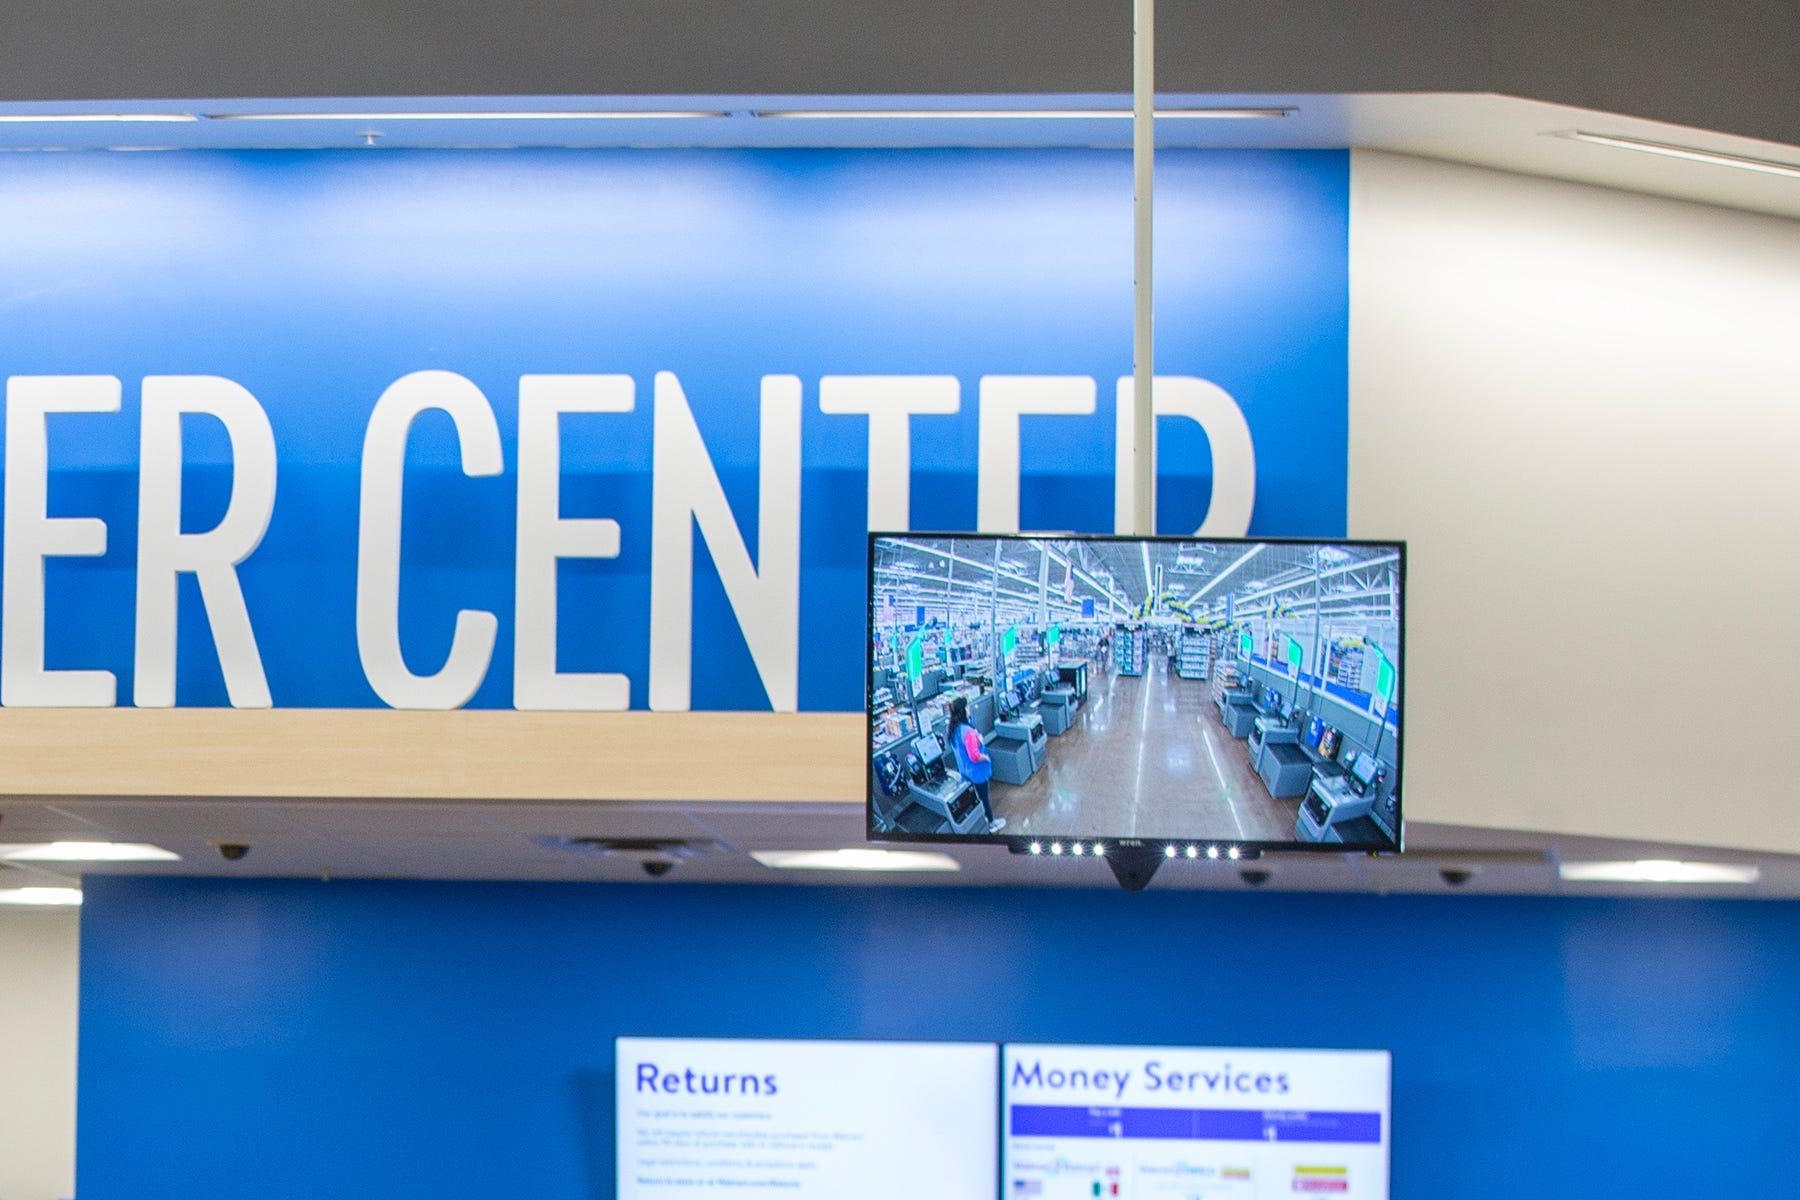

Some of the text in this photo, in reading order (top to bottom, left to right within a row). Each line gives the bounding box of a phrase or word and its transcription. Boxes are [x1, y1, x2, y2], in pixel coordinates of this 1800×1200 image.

[636, 1062, 778, 1096] Returns
[1011, 1059, 1291, 1098] Money Services
